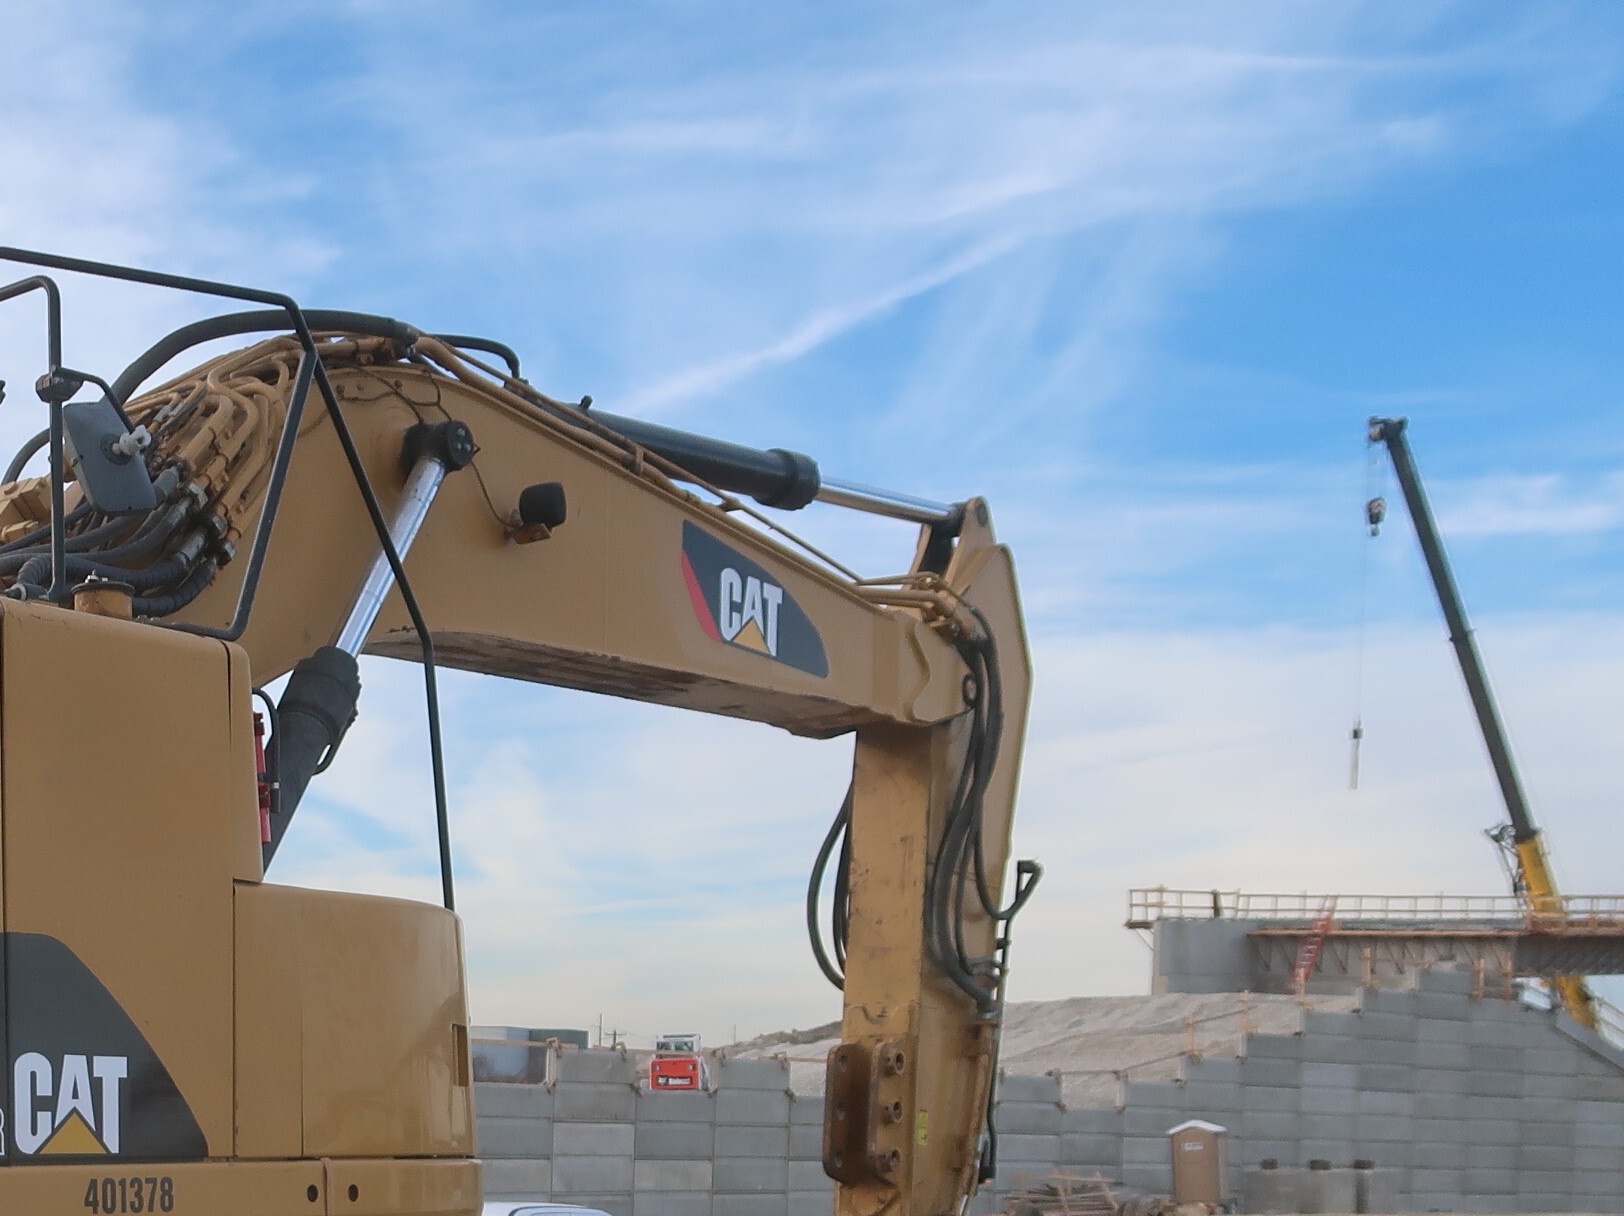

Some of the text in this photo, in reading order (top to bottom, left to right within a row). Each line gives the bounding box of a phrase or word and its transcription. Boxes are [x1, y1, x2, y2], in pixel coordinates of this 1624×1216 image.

[719, 567, 783, 657] CAT
[13, 1052, 128, 1155] CAT
[84, 1176, 175, 1215] 401378
